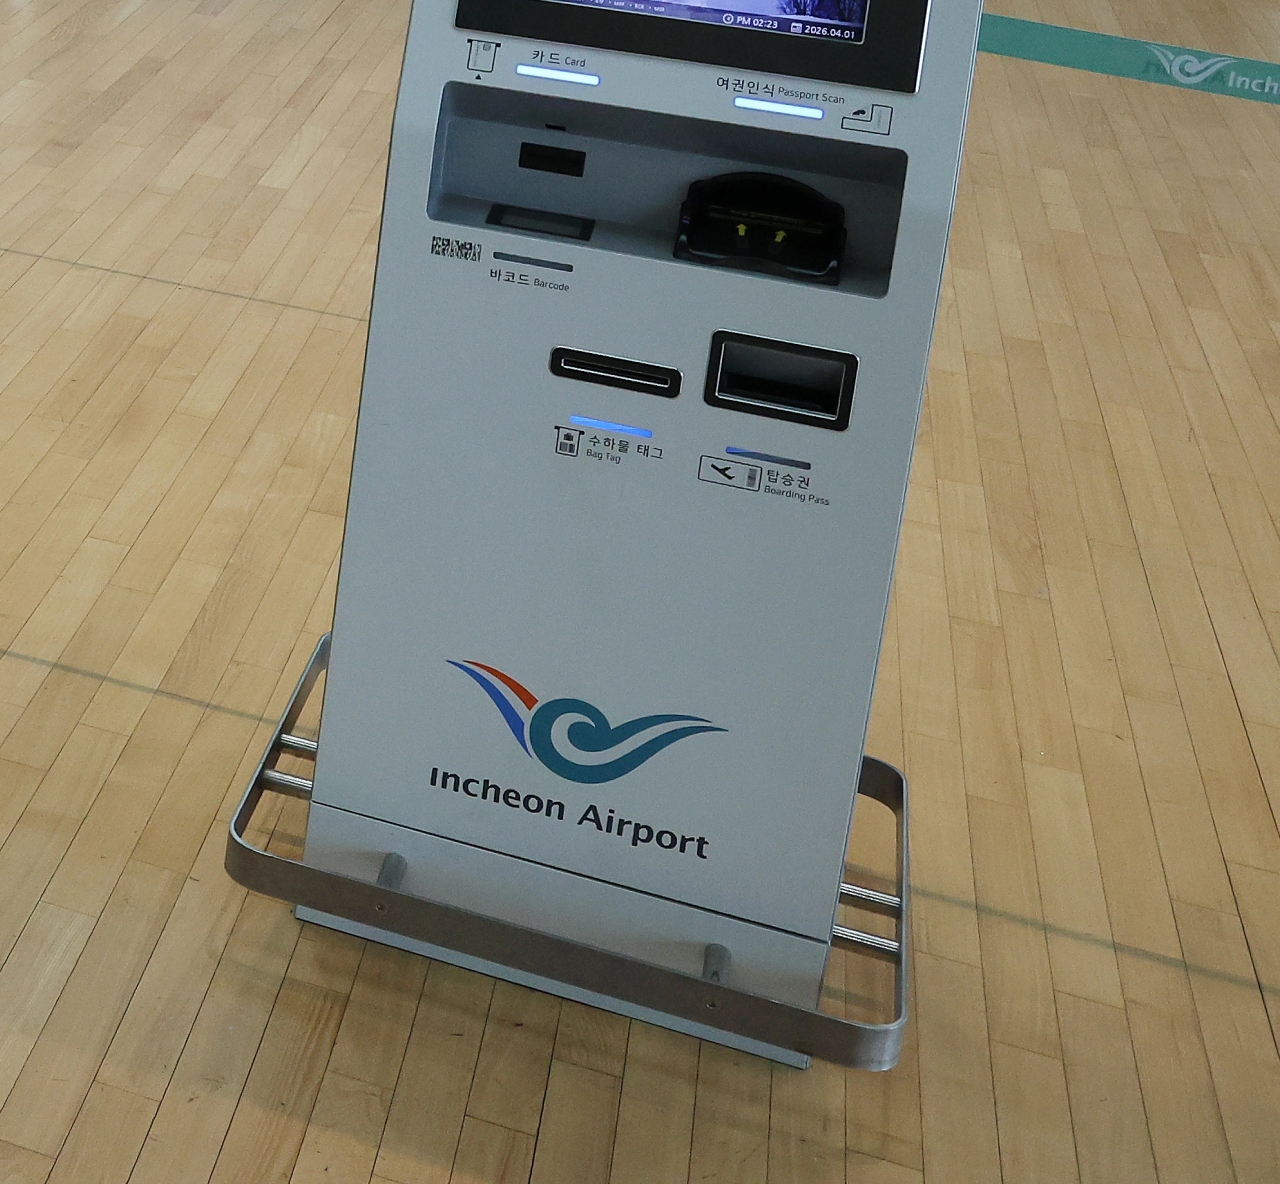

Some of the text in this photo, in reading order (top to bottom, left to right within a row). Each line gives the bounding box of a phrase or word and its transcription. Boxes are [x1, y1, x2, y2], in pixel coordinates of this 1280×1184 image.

[736, 16, 779, 29] PM 02:23
[804, 25, 856, 39] 2026.04.01
[532, 50, 586, 67] 카드 Card
[716, 76, 845, 105] 여권인식 Passport Scan
[490, 268, 570, 292] 바코드 Barcode
[586, 448, 621, 464] Bag Tag
[588, 434, 664, 460] 수하물 태그
[767, 469, 811, 490] 탑승권
[764, 485, 830, 506] Boarding Pass
[430, 766, 710, 859] Incheon Airport
